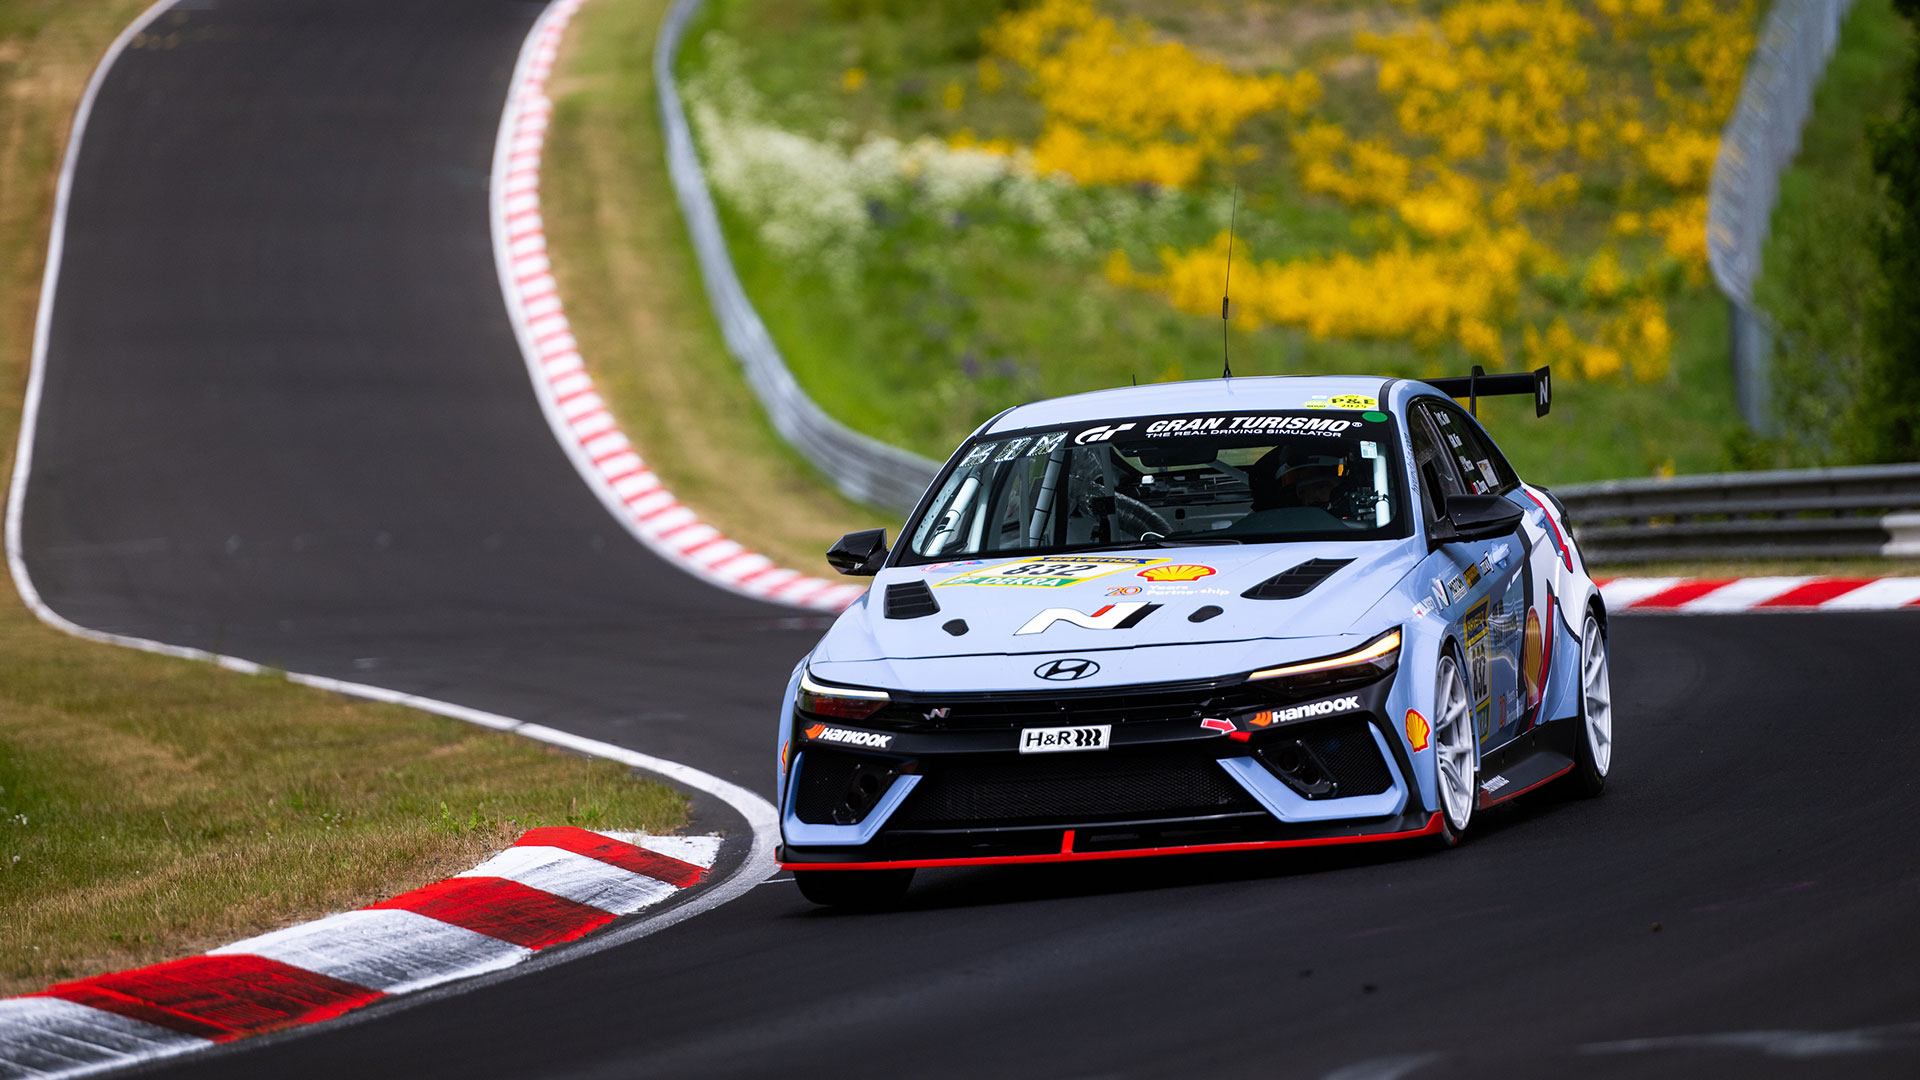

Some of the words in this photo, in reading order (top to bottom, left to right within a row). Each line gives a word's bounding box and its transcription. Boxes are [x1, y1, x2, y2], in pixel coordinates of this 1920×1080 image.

[1146, 417, 1226, 433] GRAN
[1146, 431, 1171, 439] THE
[1266, 428, 1342, 438] SIMULATOR
[1003, 563, 1099, 577] 832
[978, 577, 1060, 587] DEKRA
[1104, 585, 1143, 597] 20
[1147, 588, 1230, 597] Partneship
[1025, 731, 1071, 747] H&R
